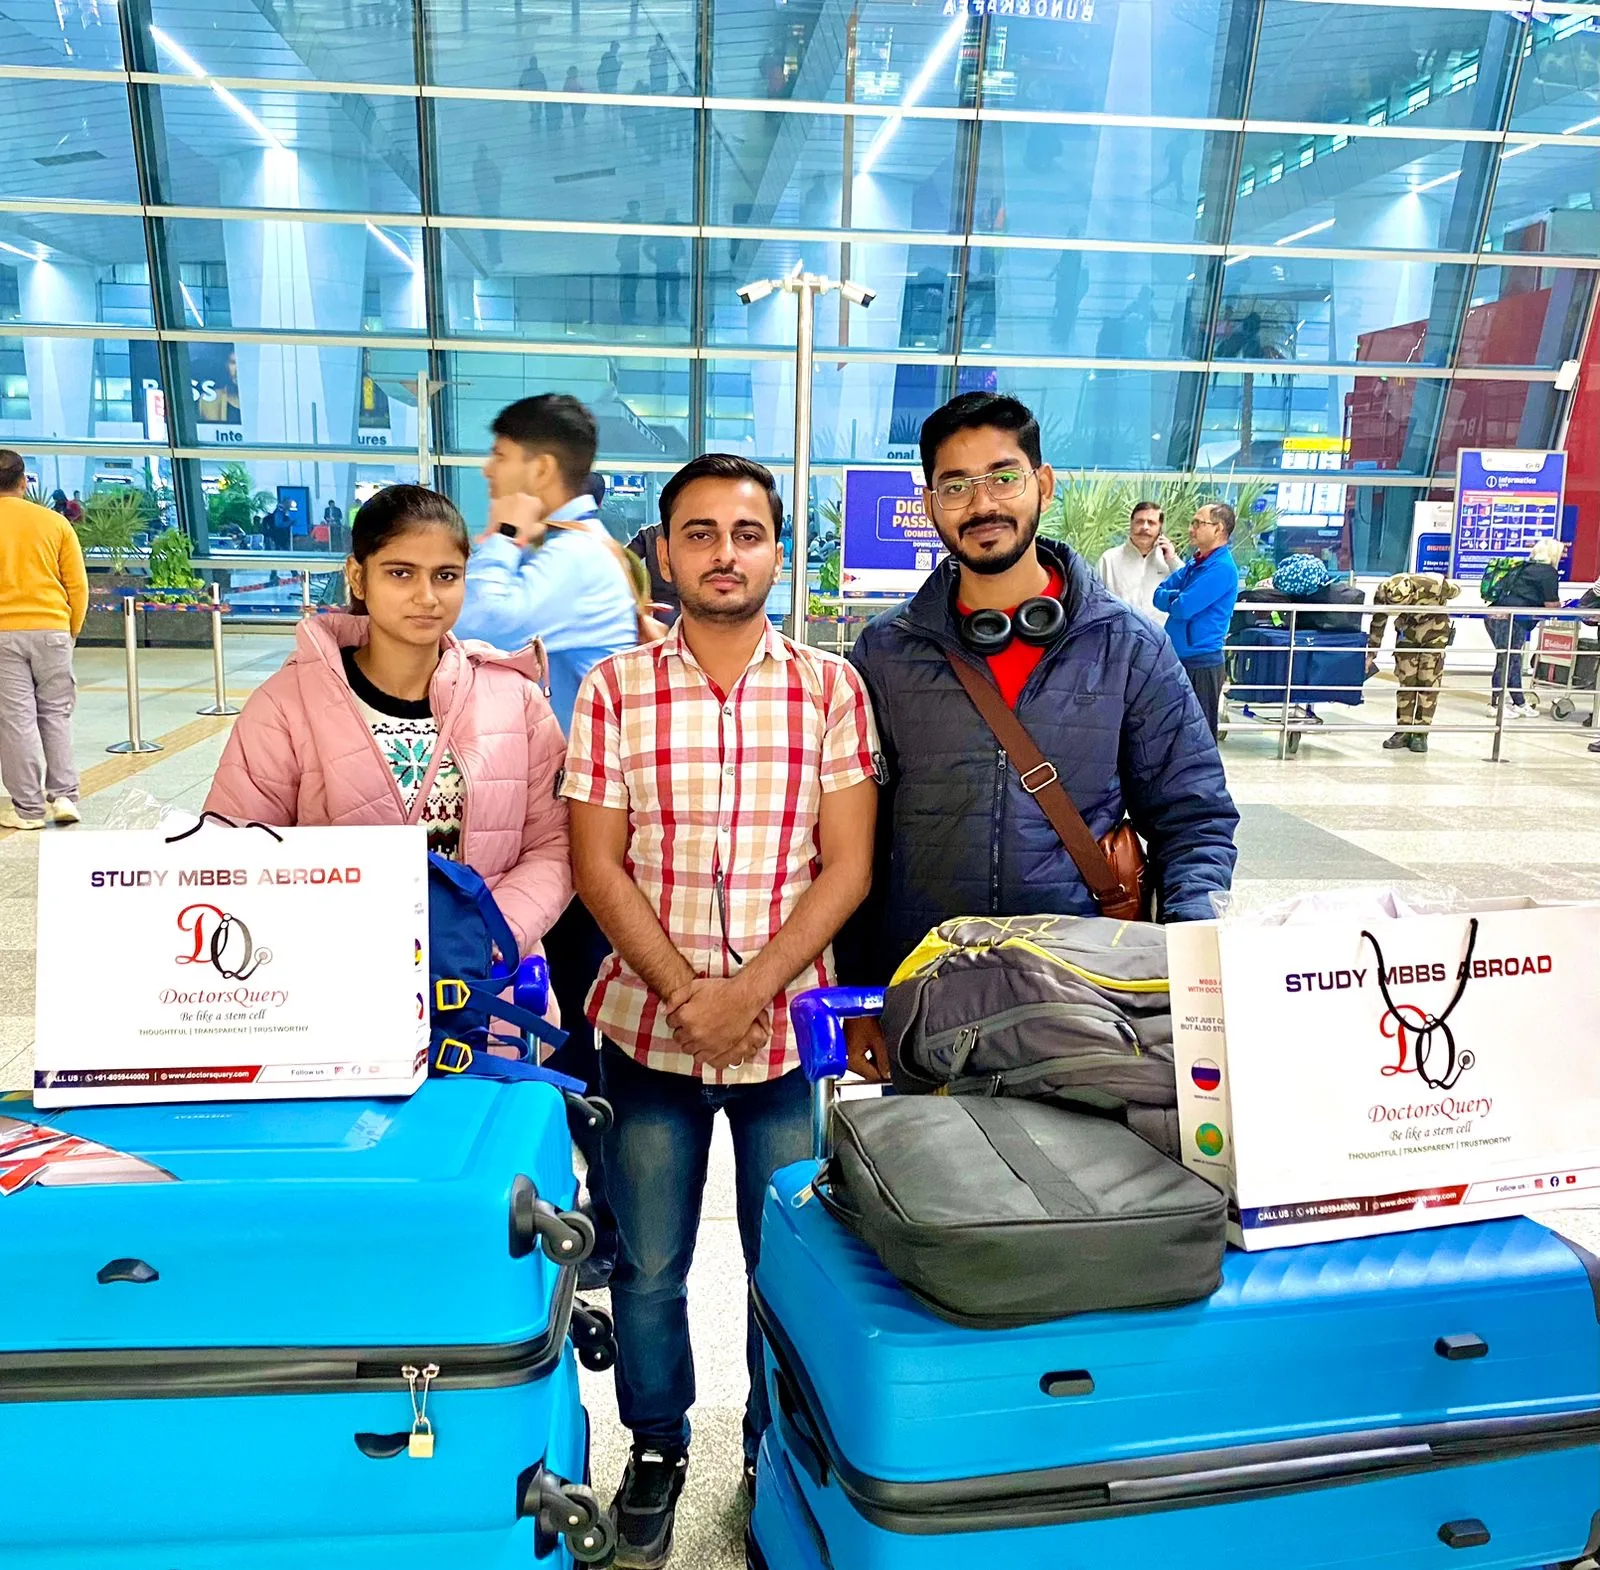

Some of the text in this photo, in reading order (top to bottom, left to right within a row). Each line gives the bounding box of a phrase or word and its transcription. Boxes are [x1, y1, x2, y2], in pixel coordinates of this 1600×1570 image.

[887, 450, 914, 460] onal
[91, 867, 361, 888] STUDY MBBS ABROAD
[1285, 954, 1553, 993] STUDY MBBS ABROAD
[158, 987, 289, 1008] DoctorsQuery
[180, 1009, 266, 1023] Be like a stem cell
[1200, 1017, 1216, 1025] JUST
[193, 1027, 247, 1035] TRANSPARENT
[1180, 1023, 1194, 1031] BUT
[1194, 1024, 1212, 1032] ALSO
[1367, 1097, 1493, 1124] DoctorsQuery
[1389, 1120, 1473, 1142] Be like a stem cell
[1348, 1150, 1398, 1160] THOUGHTFUL
[1403, 1142, 1455, 1155] TRANSPARENT
[1460, 1136, 1512, 1149] TRUSTWORTHY
[1258, 1212, 1278, 1221] CALL
[1278, 1209, 1290, 1219] US
